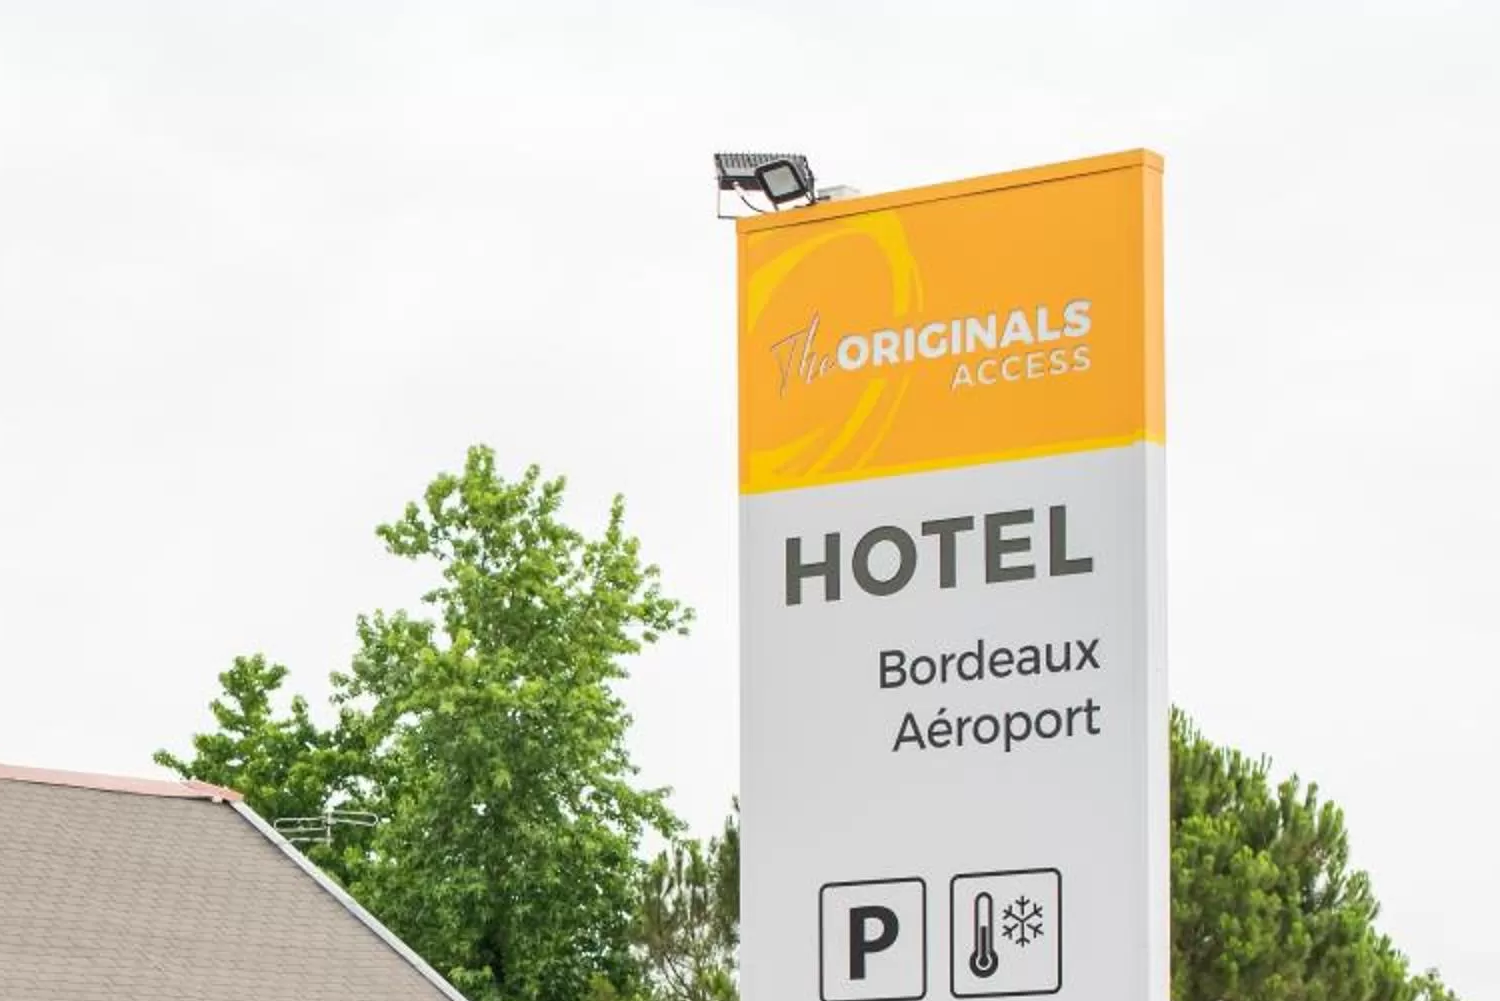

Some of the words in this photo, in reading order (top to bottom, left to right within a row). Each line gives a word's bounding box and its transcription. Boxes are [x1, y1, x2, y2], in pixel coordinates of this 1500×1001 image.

[837, 299, 1092, 371] ORIGINALS
[950, 346, 1092, 391] ACCESS
[785, 505, 1094, 605] HOTEL
[879, 637, 1101, 689] Bordeaux
[891, 698, 1101, 752] Aéroport
